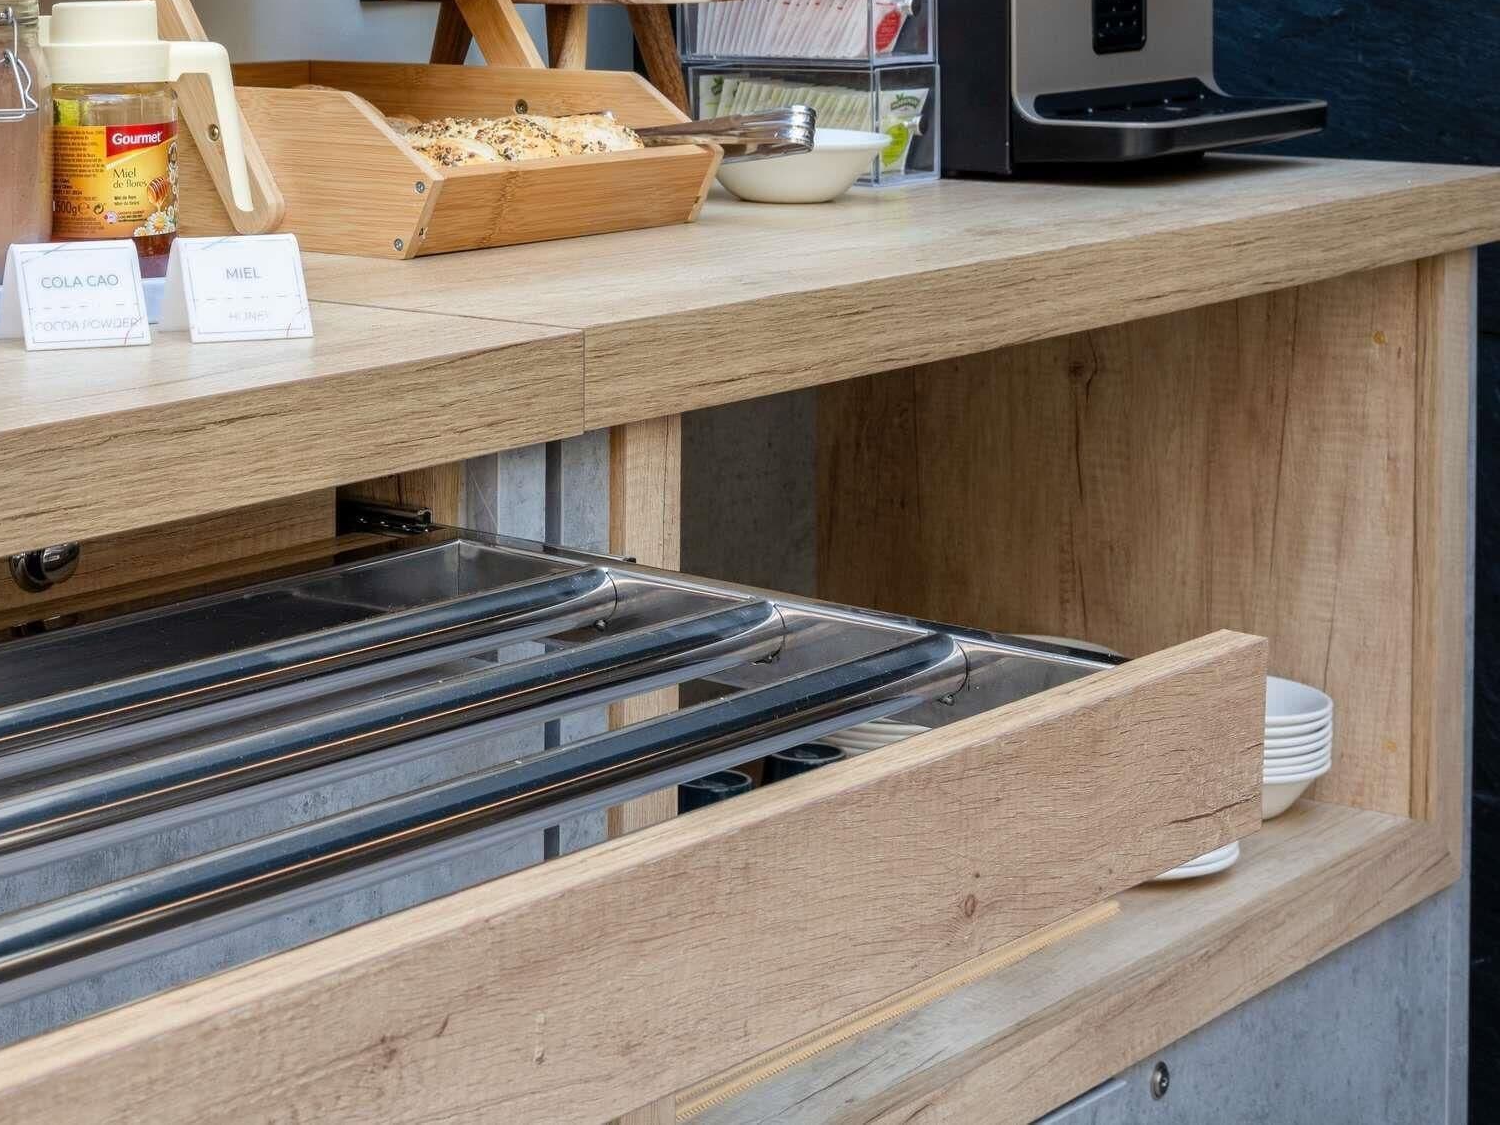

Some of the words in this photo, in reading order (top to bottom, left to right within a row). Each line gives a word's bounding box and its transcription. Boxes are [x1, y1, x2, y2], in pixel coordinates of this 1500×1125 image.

[112, 132, 161, 145] Gourmet
[113, 167, 136, 178] Miel
[113, 179, 124, 188] de
[226, 266, 261, 280] MIEL
[41, 276, 83, 289] COLA
[86, 274, 119, 287] CAO
